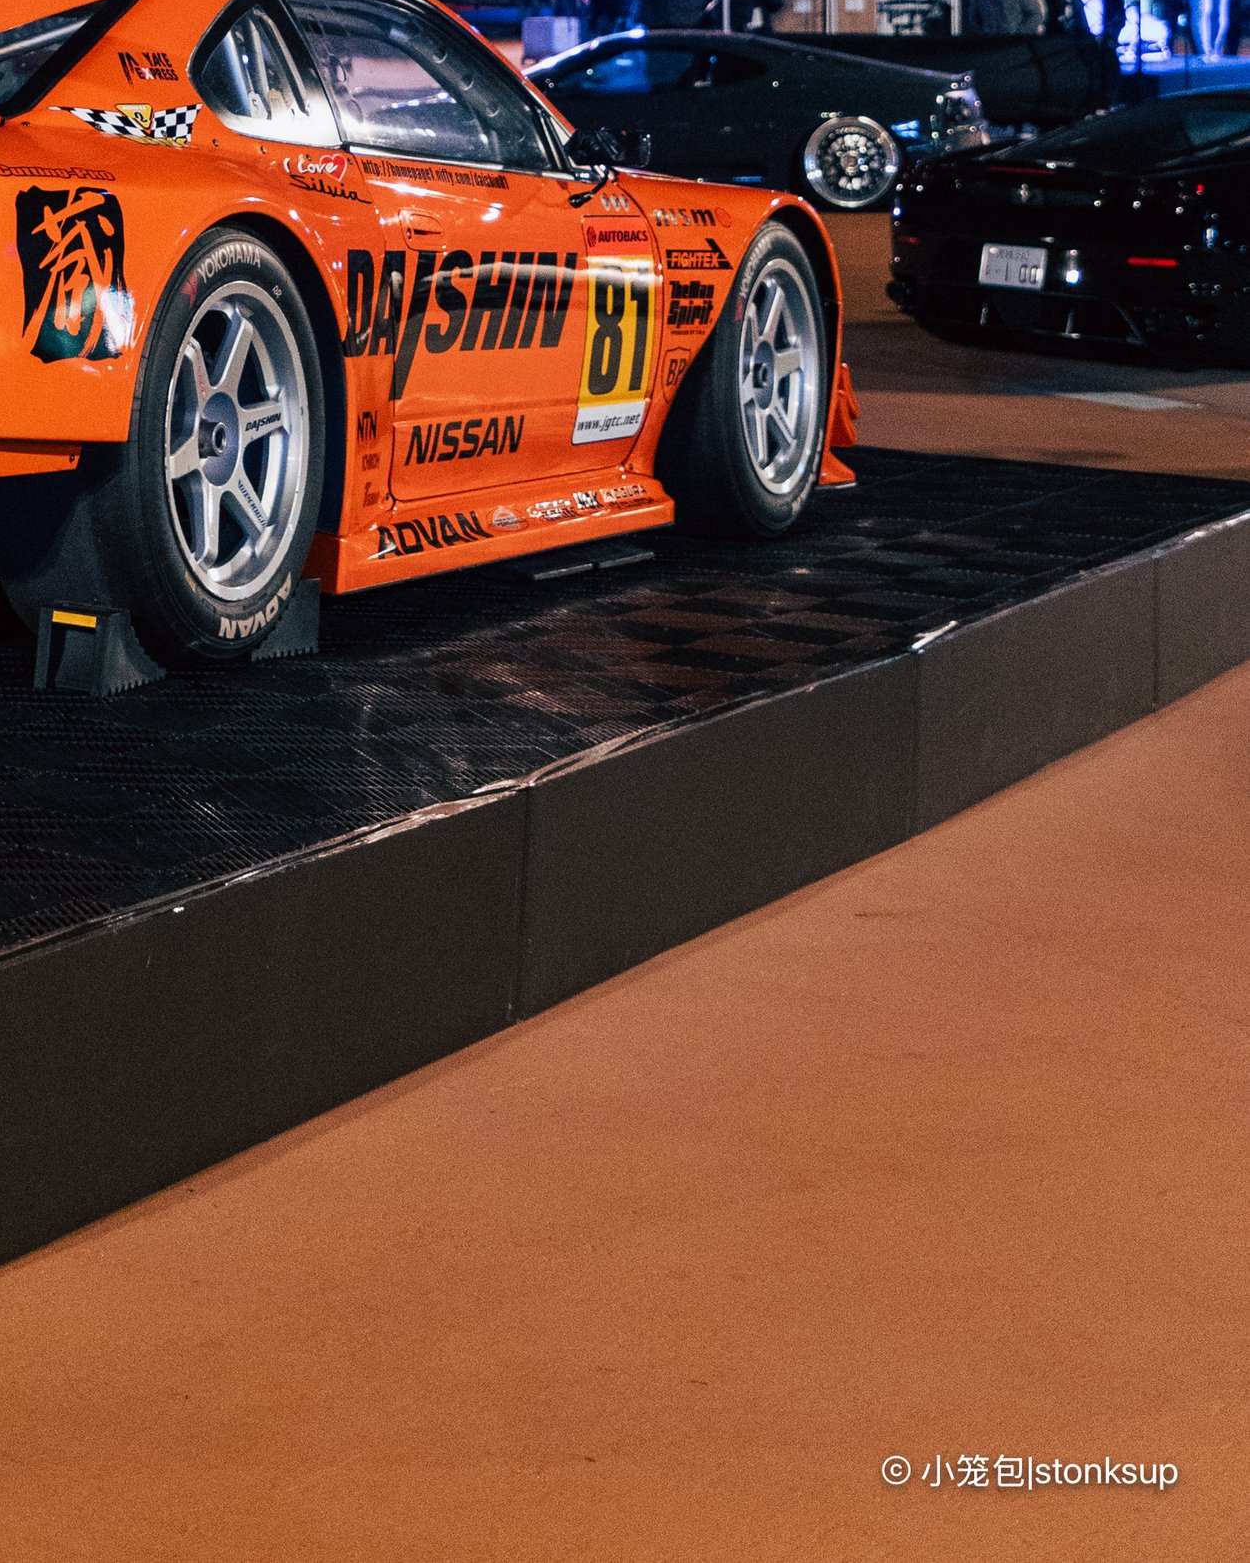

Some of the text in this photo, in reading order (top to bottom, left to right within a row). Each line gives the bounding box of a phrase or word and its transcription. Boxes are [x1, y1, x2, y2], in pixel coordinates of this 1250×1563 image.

[136, 67, 179, 81] EXPRESS
[297, 154, 339, 174] Love
[289, 174, 372, 204] Silvia
[598, 230, 648, 242] AUTOBACS
[197, 243, 261, 283] YOKOHAMA
[344, 249, 578, 401] DAISHIN
[667, 299, 714, 329] Spirit
[588, 265, 649, 395] 81
[245, 412, 282, 432] DAISHIN
[357, 410, 378, 442] NTN
[577, 413, 641, 432] www.jgtc.net
[405, 415, 525, 466] NISSAN
[377, 511, 494, 559] ADVAN
[218, 571, 292, 639] ADVAN
